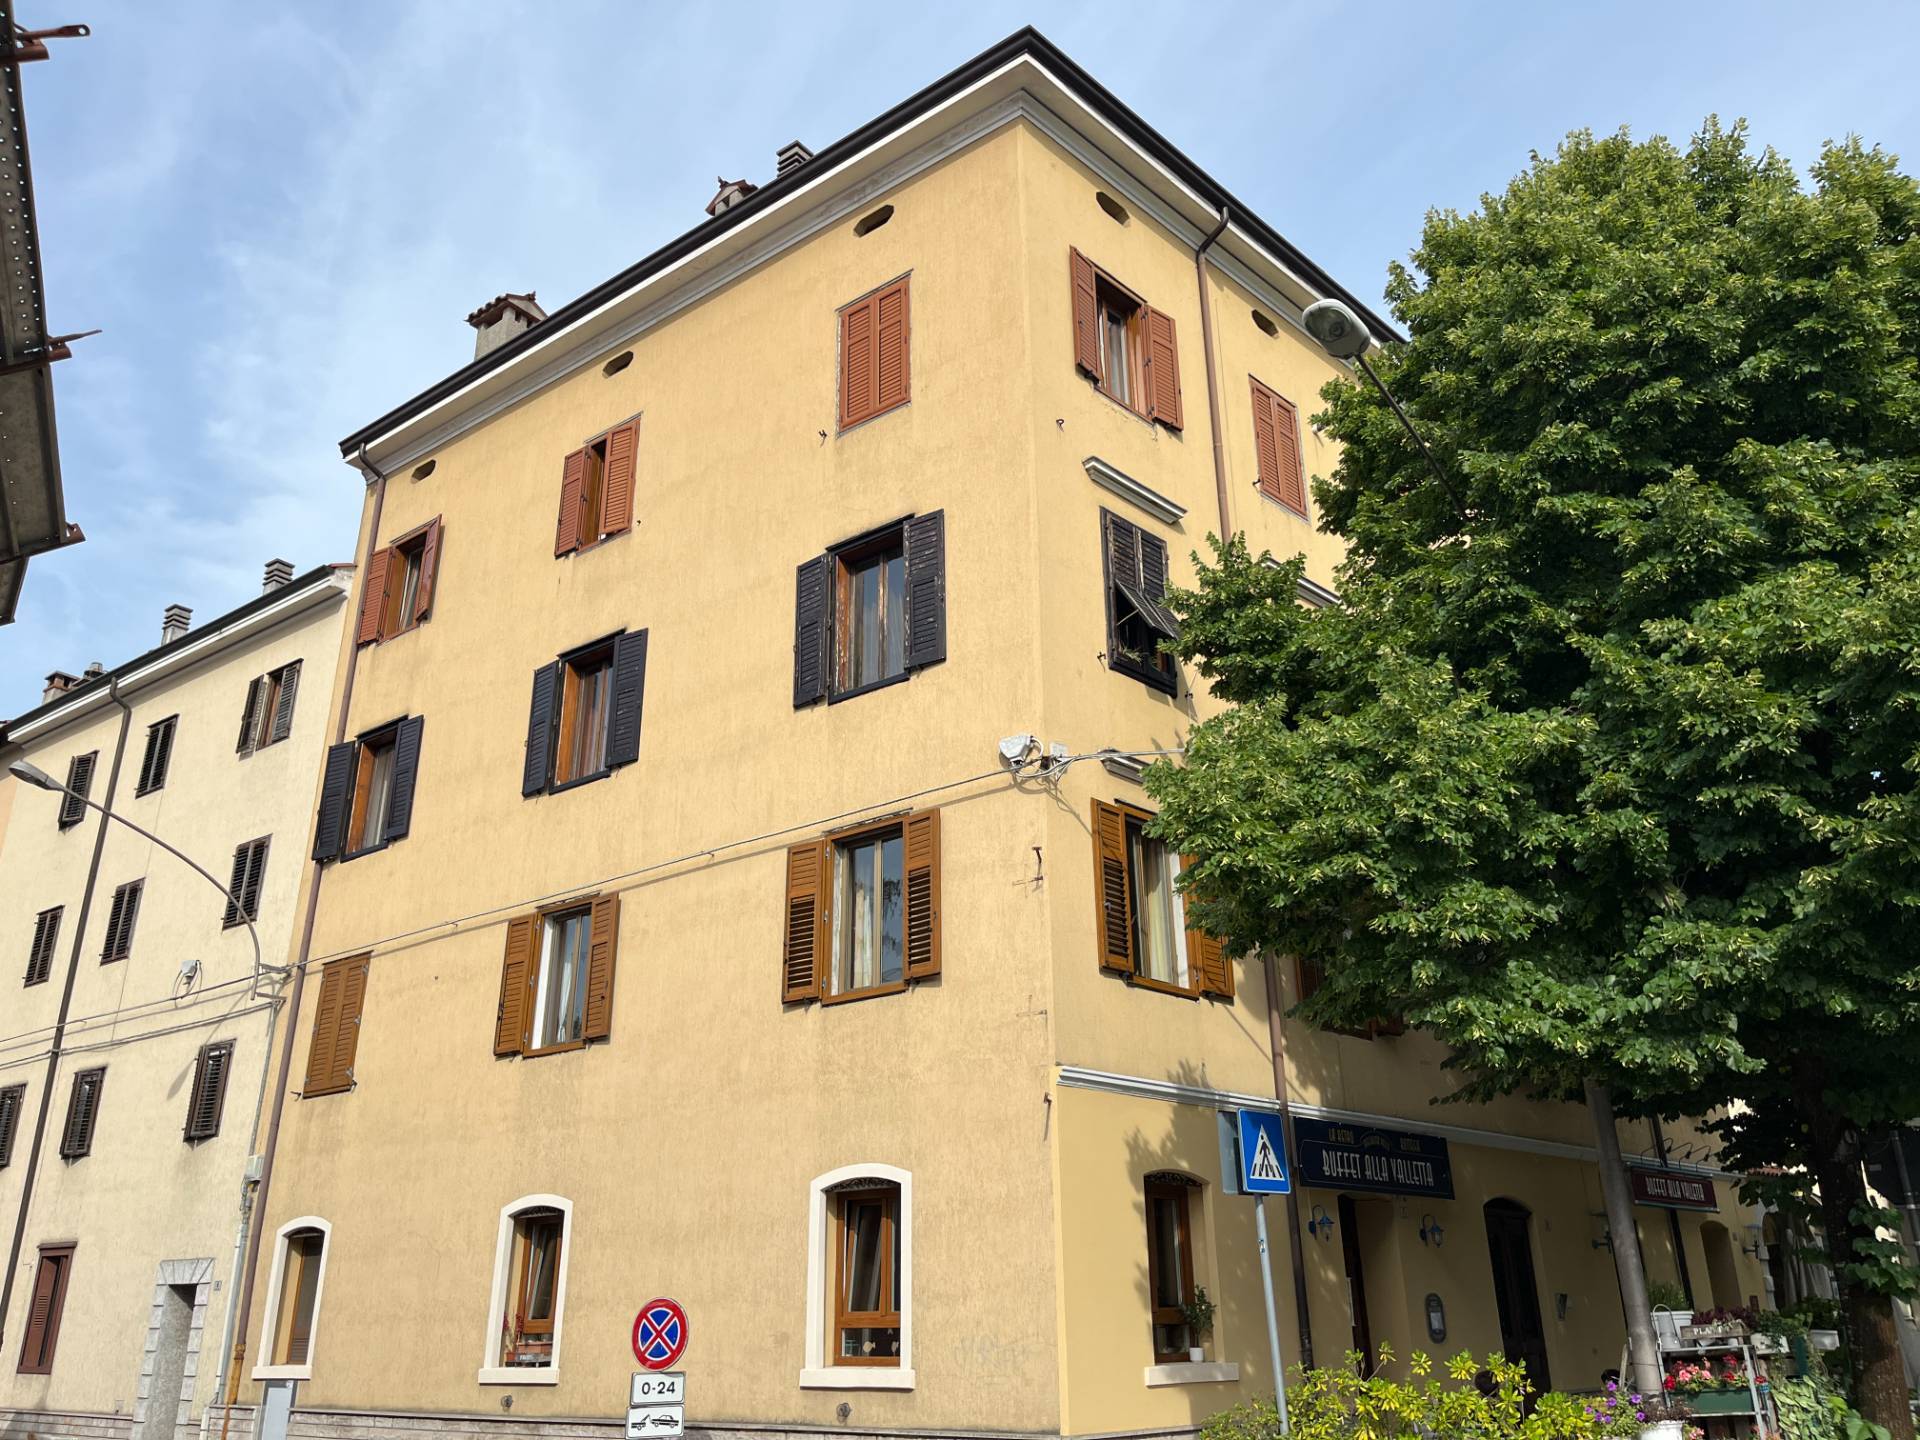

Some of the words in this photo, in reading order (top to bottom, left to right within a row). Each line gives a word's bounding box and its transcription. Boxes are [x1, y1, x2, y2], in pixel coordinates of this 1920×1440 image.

[1322, 1149, 1361, 1179] BUFFET
[1364, 1154, 1389, 1182] ALLA
[1390, 1158, 1434, 1187] VALLETTA
[1645, 1175, 1667, 1197] BUFFET
[1667, 1178, 1682, 1199] ALLA
[1681, 1181, 1704, 1201] VALLETTA
[641, 1381, 676, 1395] 0-24
